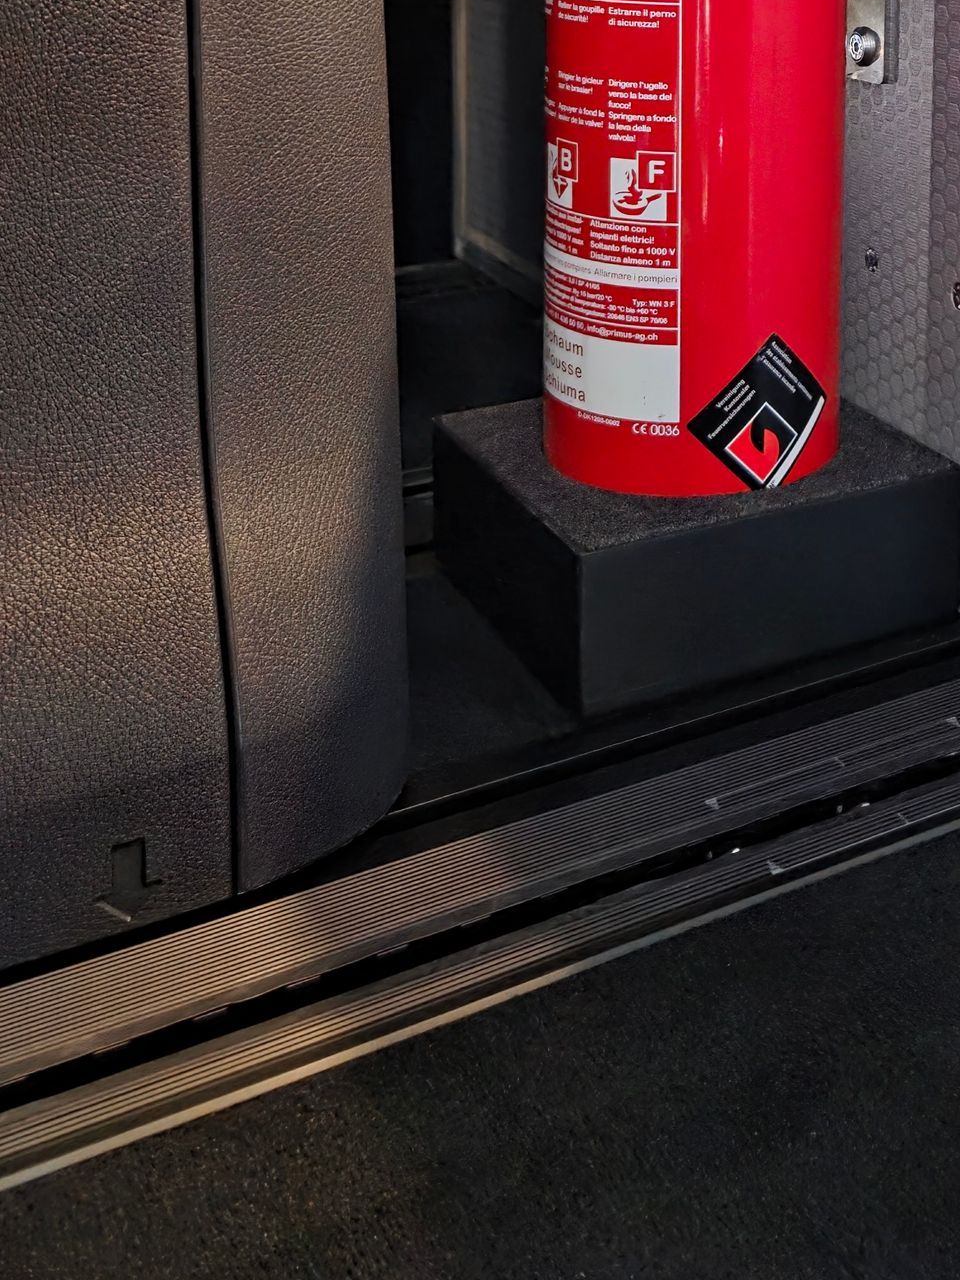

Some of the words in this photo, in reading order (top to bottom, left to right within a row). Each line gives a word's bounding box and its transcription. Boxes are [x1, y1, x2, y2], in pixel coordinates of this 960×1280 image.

[650, 11, 676, 19] perno
[608, 18, 615, 26] di
[617, 19, 660, 28] sicurezza!
[608, 79, 638, 90] Dirigere
[608, 91, 628, 99] verso
[638, 92, 658, 100] base
[608, 100, 631, 109] fuoco!
[608, 111, 645, 122] Springere
[653, 114, 677, 123] fondo
[616, 122, 631, 131] leva
[632, 124, 651, 132] della
[608, 134, 636, 142] valvola!
[562, 149, 572, 172] B
[649, 160, 666, 184] F
[590, 220, 629, 232] Attenzione
[620, 233, 655, 245] elettrici!
[590, 240, 620, 252] Soltanto
[621, 244, 636, 254] fino
[647, 248, 667, 256] 1000
[668, 248, 676, 256] V
[590, 251, 621, 262] Distanza
[622, 255, 653, 266] almeno
[594, 267, 632, 280] Allarmare
[638, 275, 678, 285] pompieri
[632, 299, 647, 307] Typ:
[625, 306, 635, 314] bis
[587, 324, 658, 341] info@primus-ag.ch
[716, 379, 746, 408] Vereinigung
[723, 384, 750, 412] Kantonaler
[708, 389, 756, 440] Feuerversicherungen
[650, 424, 680, 436] 0036
